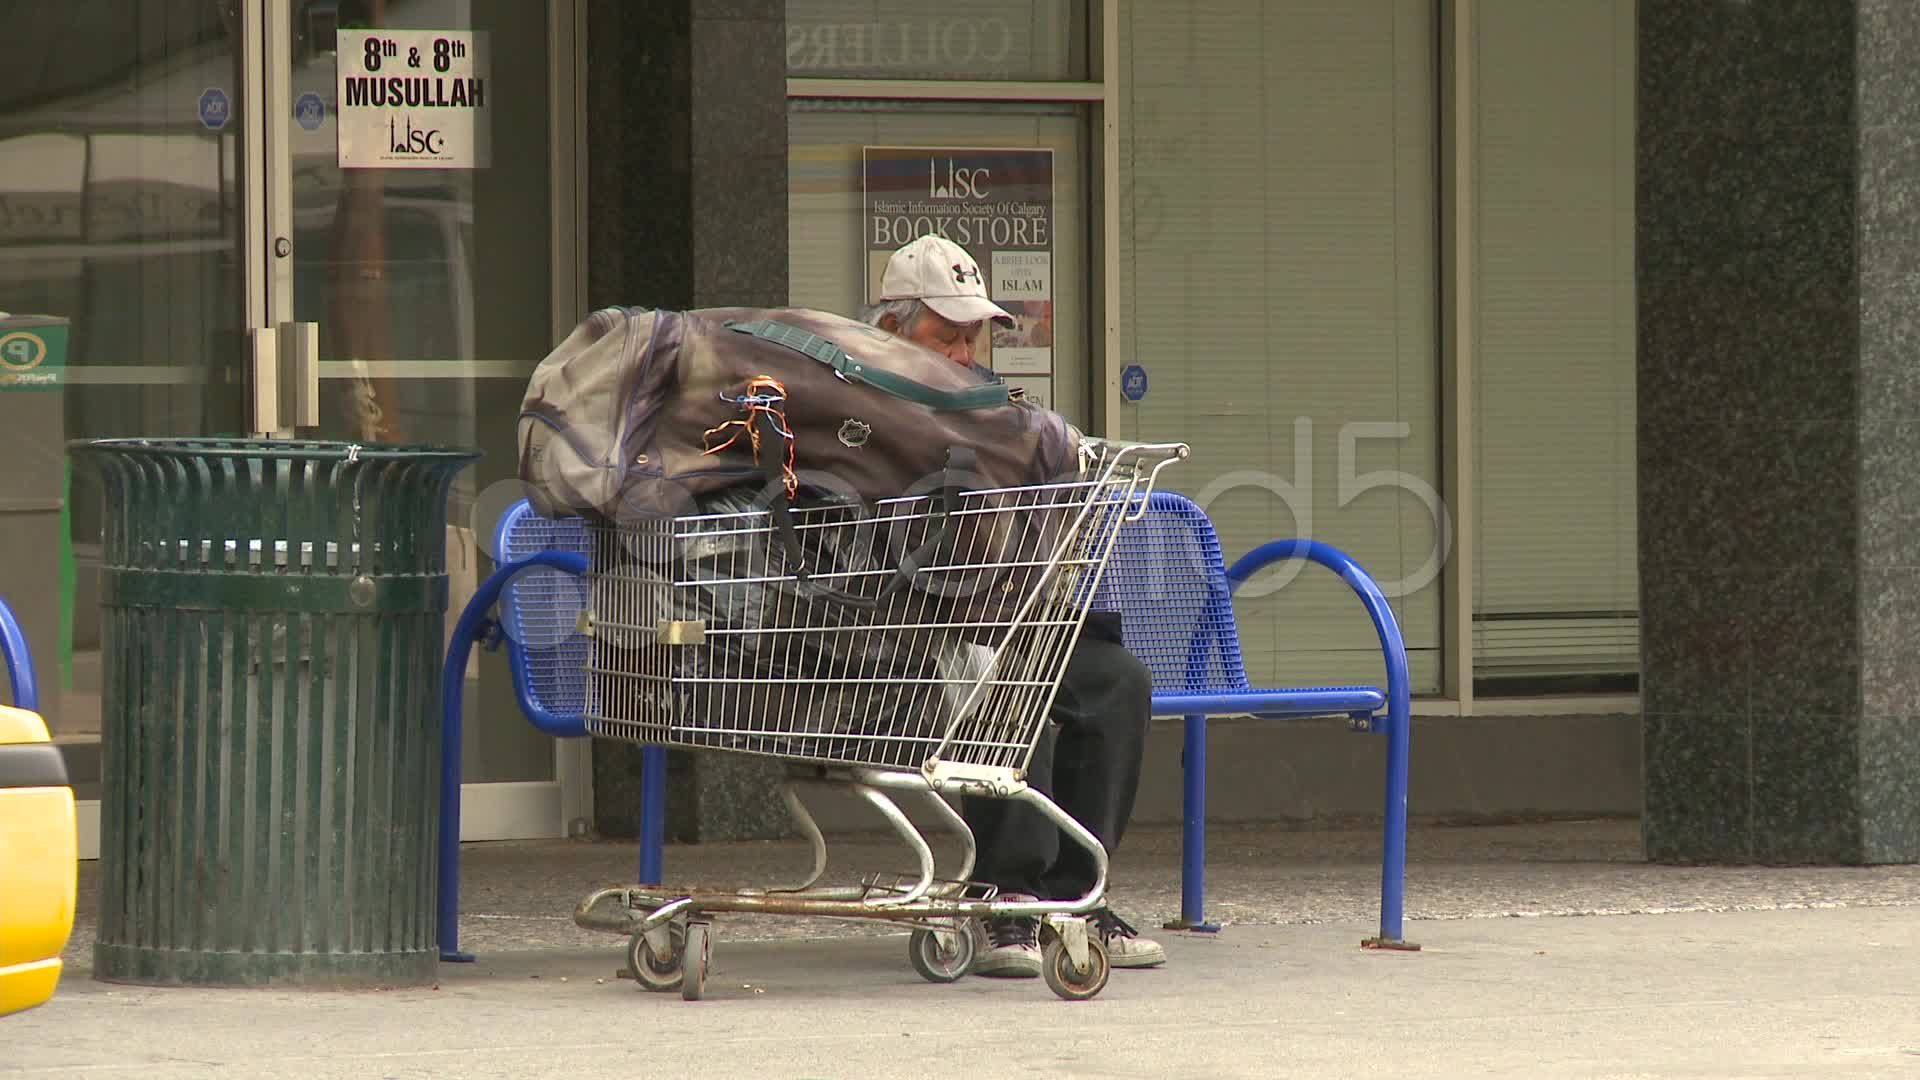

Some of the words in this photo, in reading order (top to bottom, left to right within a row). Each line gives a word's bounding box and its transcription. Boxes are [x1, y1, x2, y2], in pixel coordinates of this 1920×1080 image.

[364, 37, 397, 71] 8th
[407, 47, 420, 68] &
[433, 38, 465, 72] 8th
[345, 77, 484, 107] MUSULLAH
[874, 201, 906, 214] Islamic
[908, 202, 961, 215] Information
[962, 202, 994, 217] Society
[997, 202, 1010, 214] Of
[1010, 202, 1046, 218] Calgary
[873, 216, 1048, 246] BOOKSTORE
[1002, 279, 1043, 291] ISLAM
